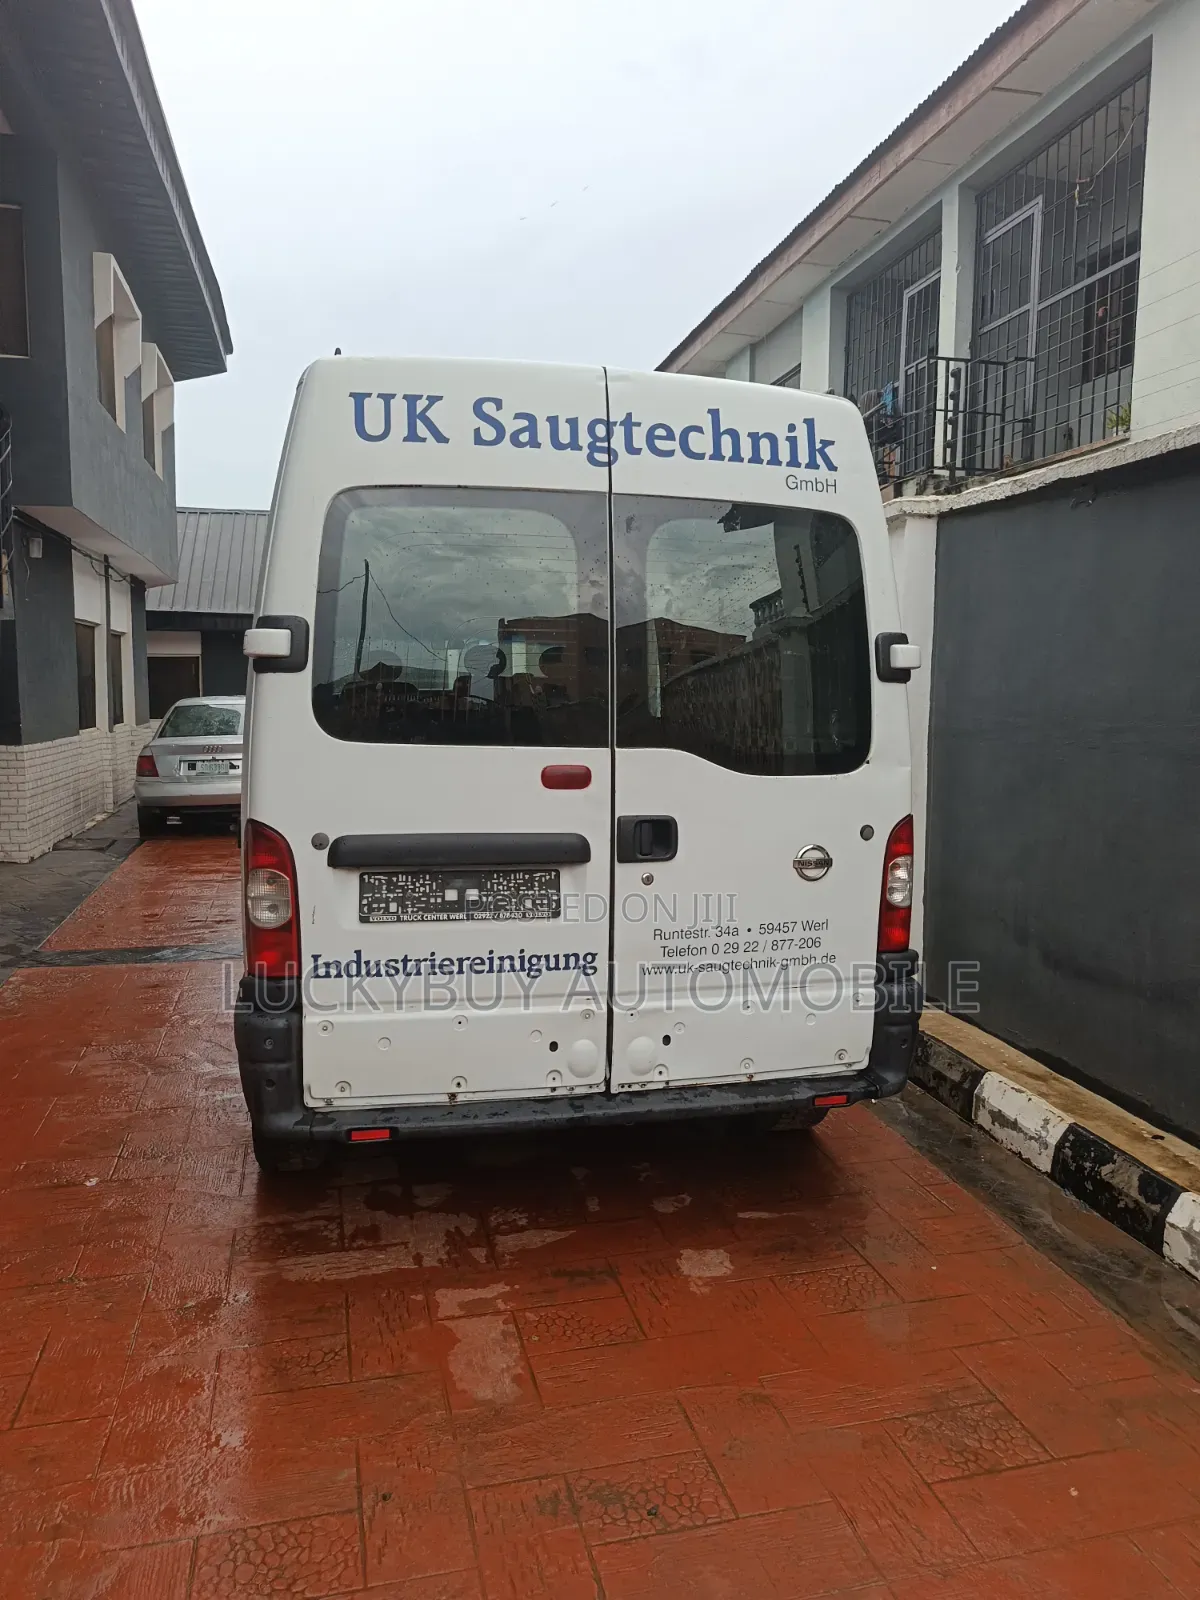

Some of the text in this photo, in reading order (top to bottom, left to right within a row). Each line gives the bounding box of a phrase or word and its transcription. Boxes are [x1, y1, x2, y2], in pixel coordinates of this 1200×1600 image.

[349, 392, 838, 471] UK Saugtechnik
[785, 474, 837, 495] GmbH
[653, 919, 829, 941] Runtestr. 34a 59457 Werl
[661, 944, 708, 958] Telefon
[711, 943, 720, 955] 0
[723, 942, 740, 954] 29
[743, 941, 759, 953] 22
[771, 937, 822, 951] 877-206
[310, 949, 599, 979] Industriereinigung
[642, 953, 837, 976] www.uk-saugtechnik-gmbh.de
